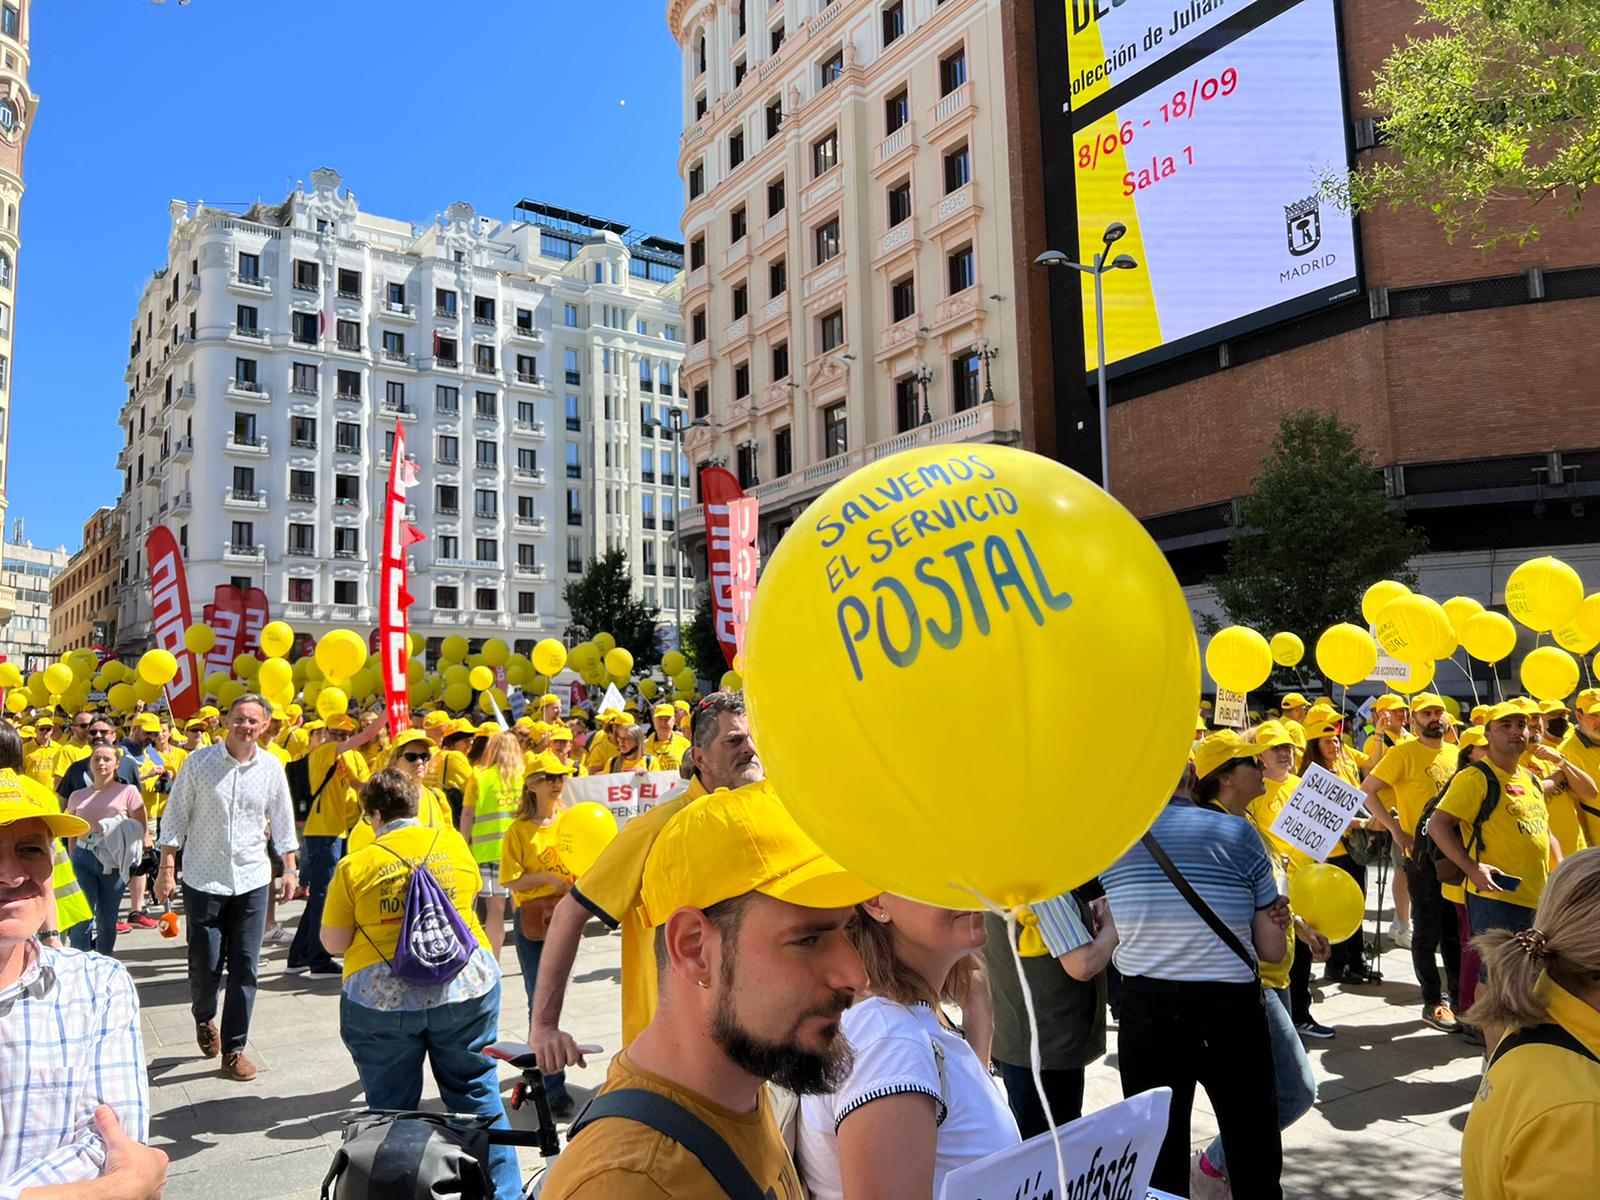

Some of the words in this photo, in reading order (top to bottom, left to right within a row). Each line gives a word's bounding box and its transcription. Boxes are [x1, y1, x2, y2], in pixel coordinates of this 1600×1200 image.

[1143, 26, 1163, 52] de
[1078, 120, 1134, 171] 8/06
[1159, 67, 1238, 123] 18/09
[1122, 156, 1177, 197] Sala
[1183, 145, 1194, 165] 1
[1279, 253, 1336, 283] MADRID
[816, 454, 996, 548] SALVEMOS
[826, 555, 860, 594] EL
[868, 487, 1019, 564] SERVICIO
[837, 528, 1073, 682] POSTAL
[608, 784, 632, 802] ES
[1290, 792, 1304, 811] EL
[1303, 800, 1343, 832] CORREO
[1301, 773, 1358, 811] ¡SALVEMOS
